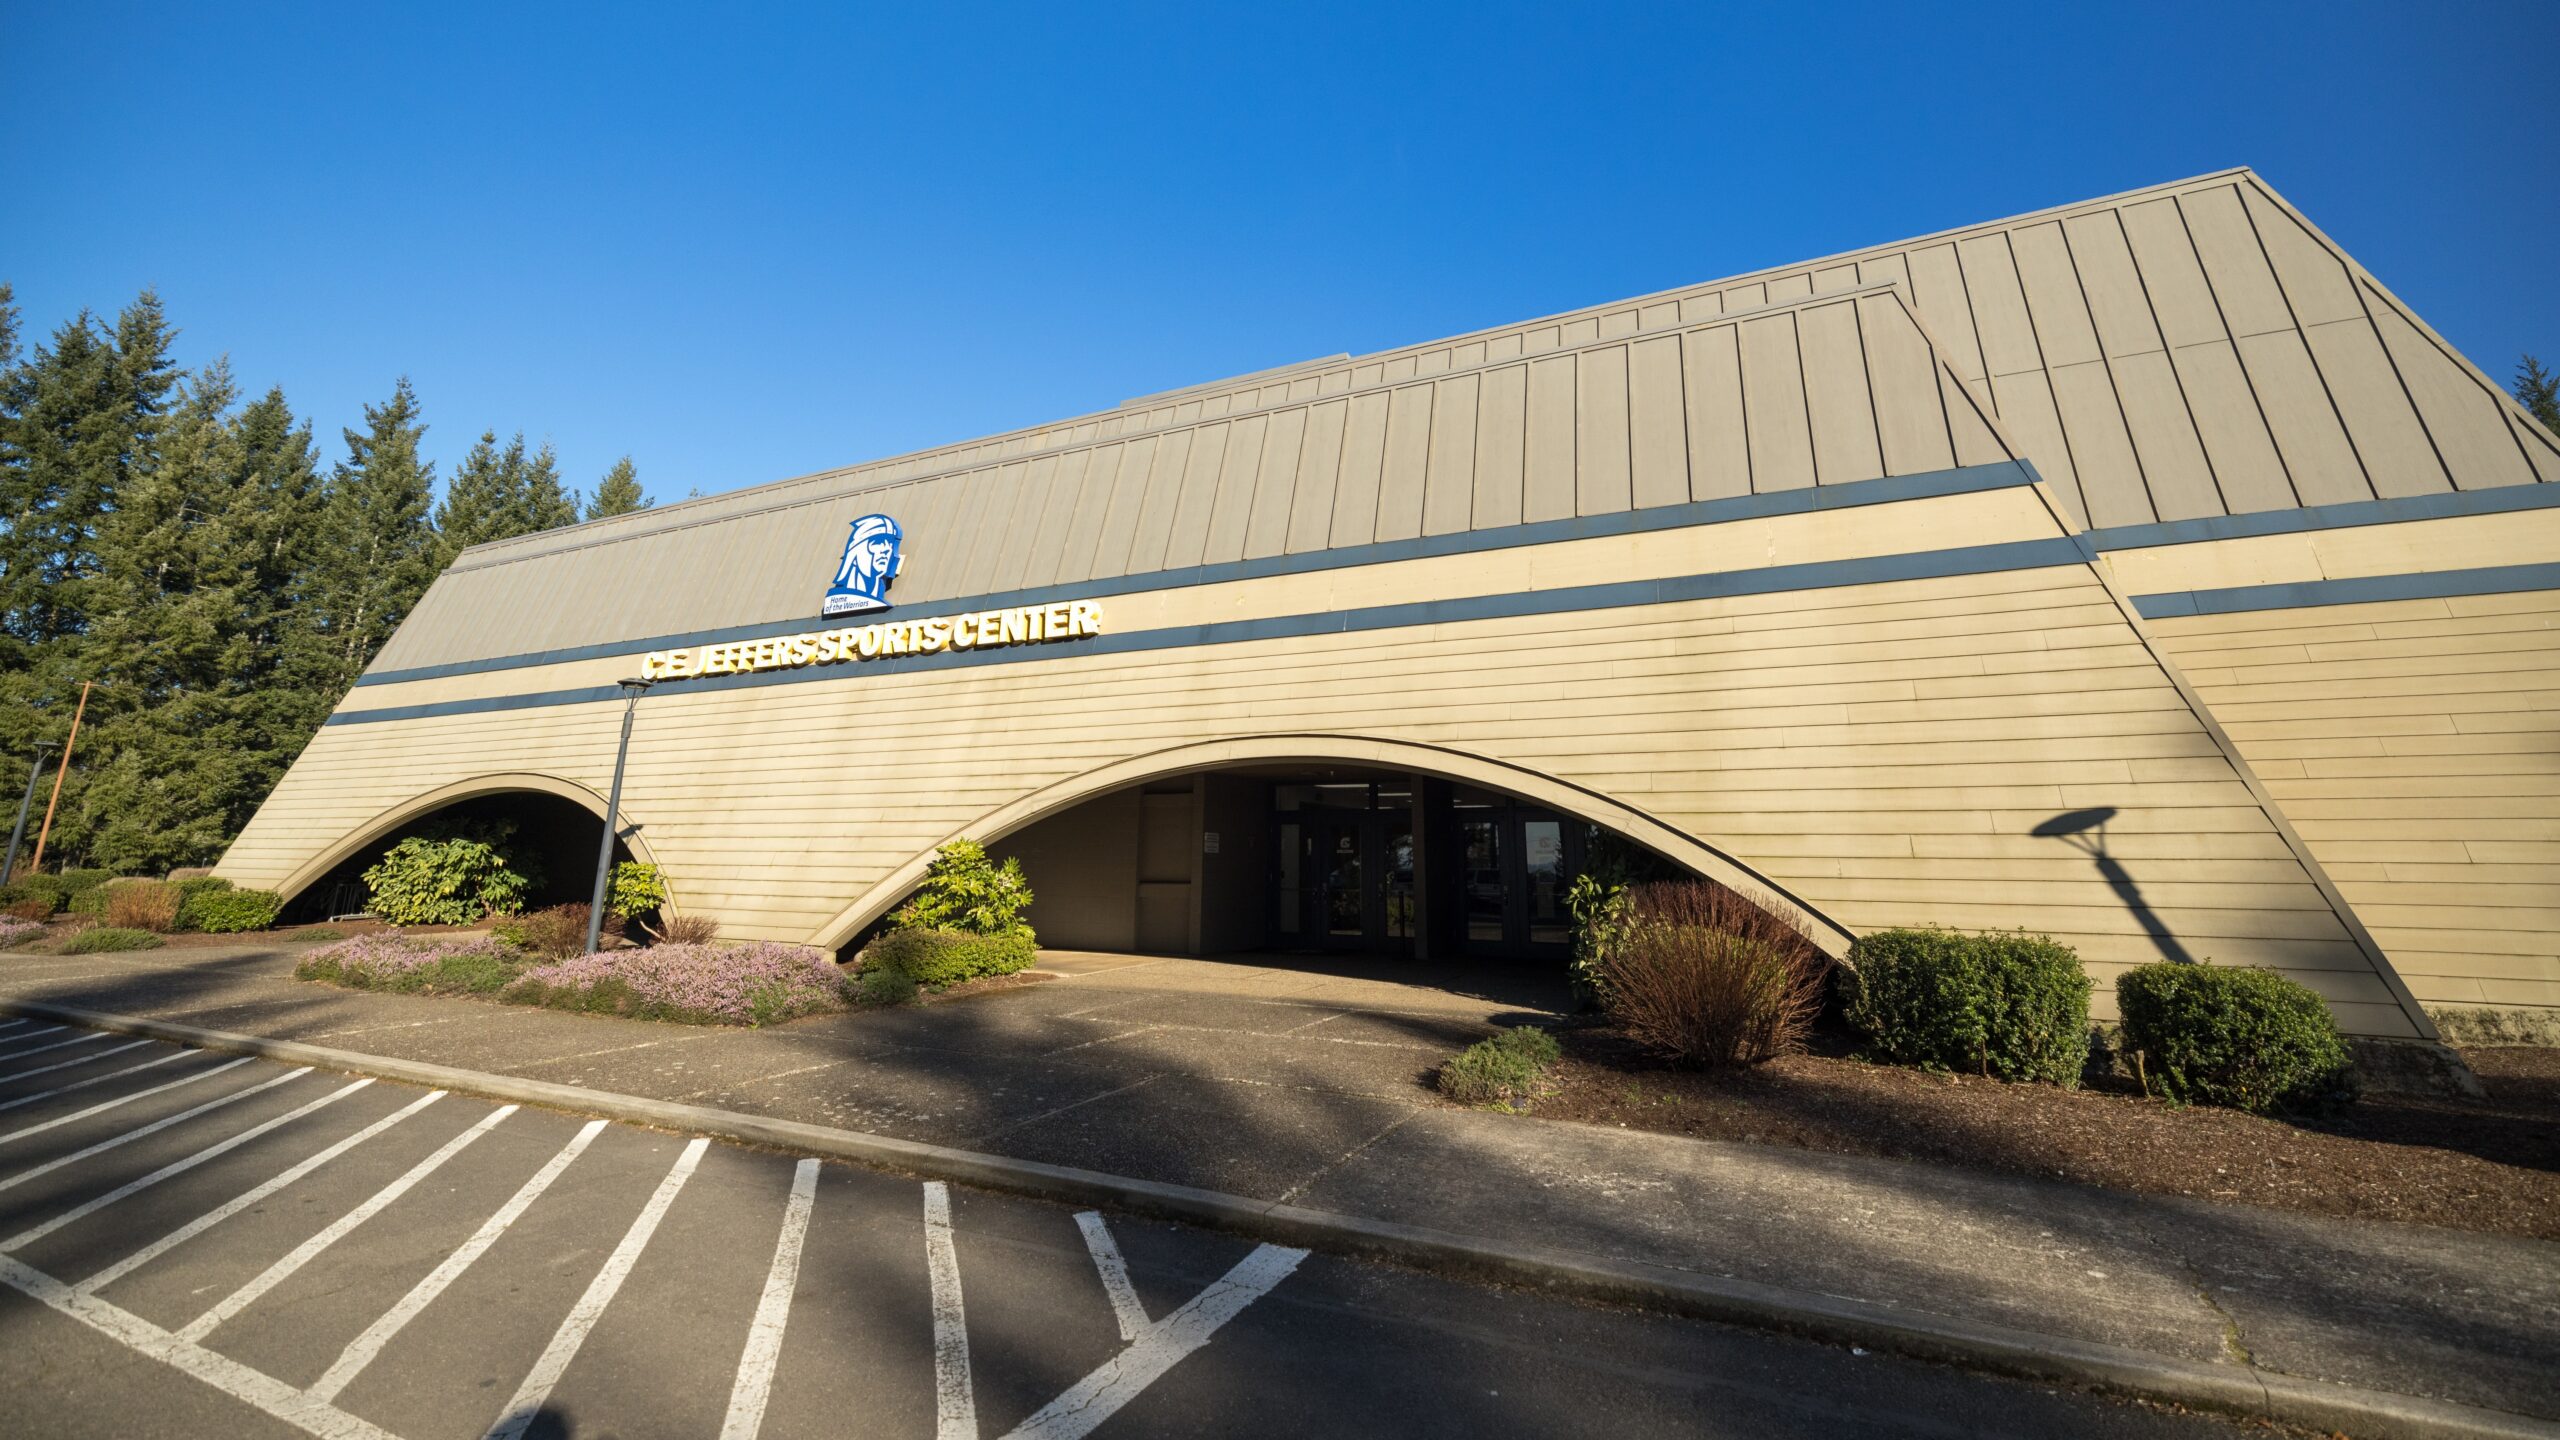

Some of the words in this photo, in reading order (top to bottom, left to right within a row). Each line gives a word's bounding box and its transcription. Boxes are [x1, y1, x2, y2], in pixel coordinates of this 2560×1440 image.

[825, 604, 833, 613] of
[833, 603, 843, 611] the
[843, 600, 869, 610] Warriors
[693, 633, 816, 676] JEFFERS
[816, 617, 951, 663] SPORTS
[952, 600, 1101, 649] CENTER
